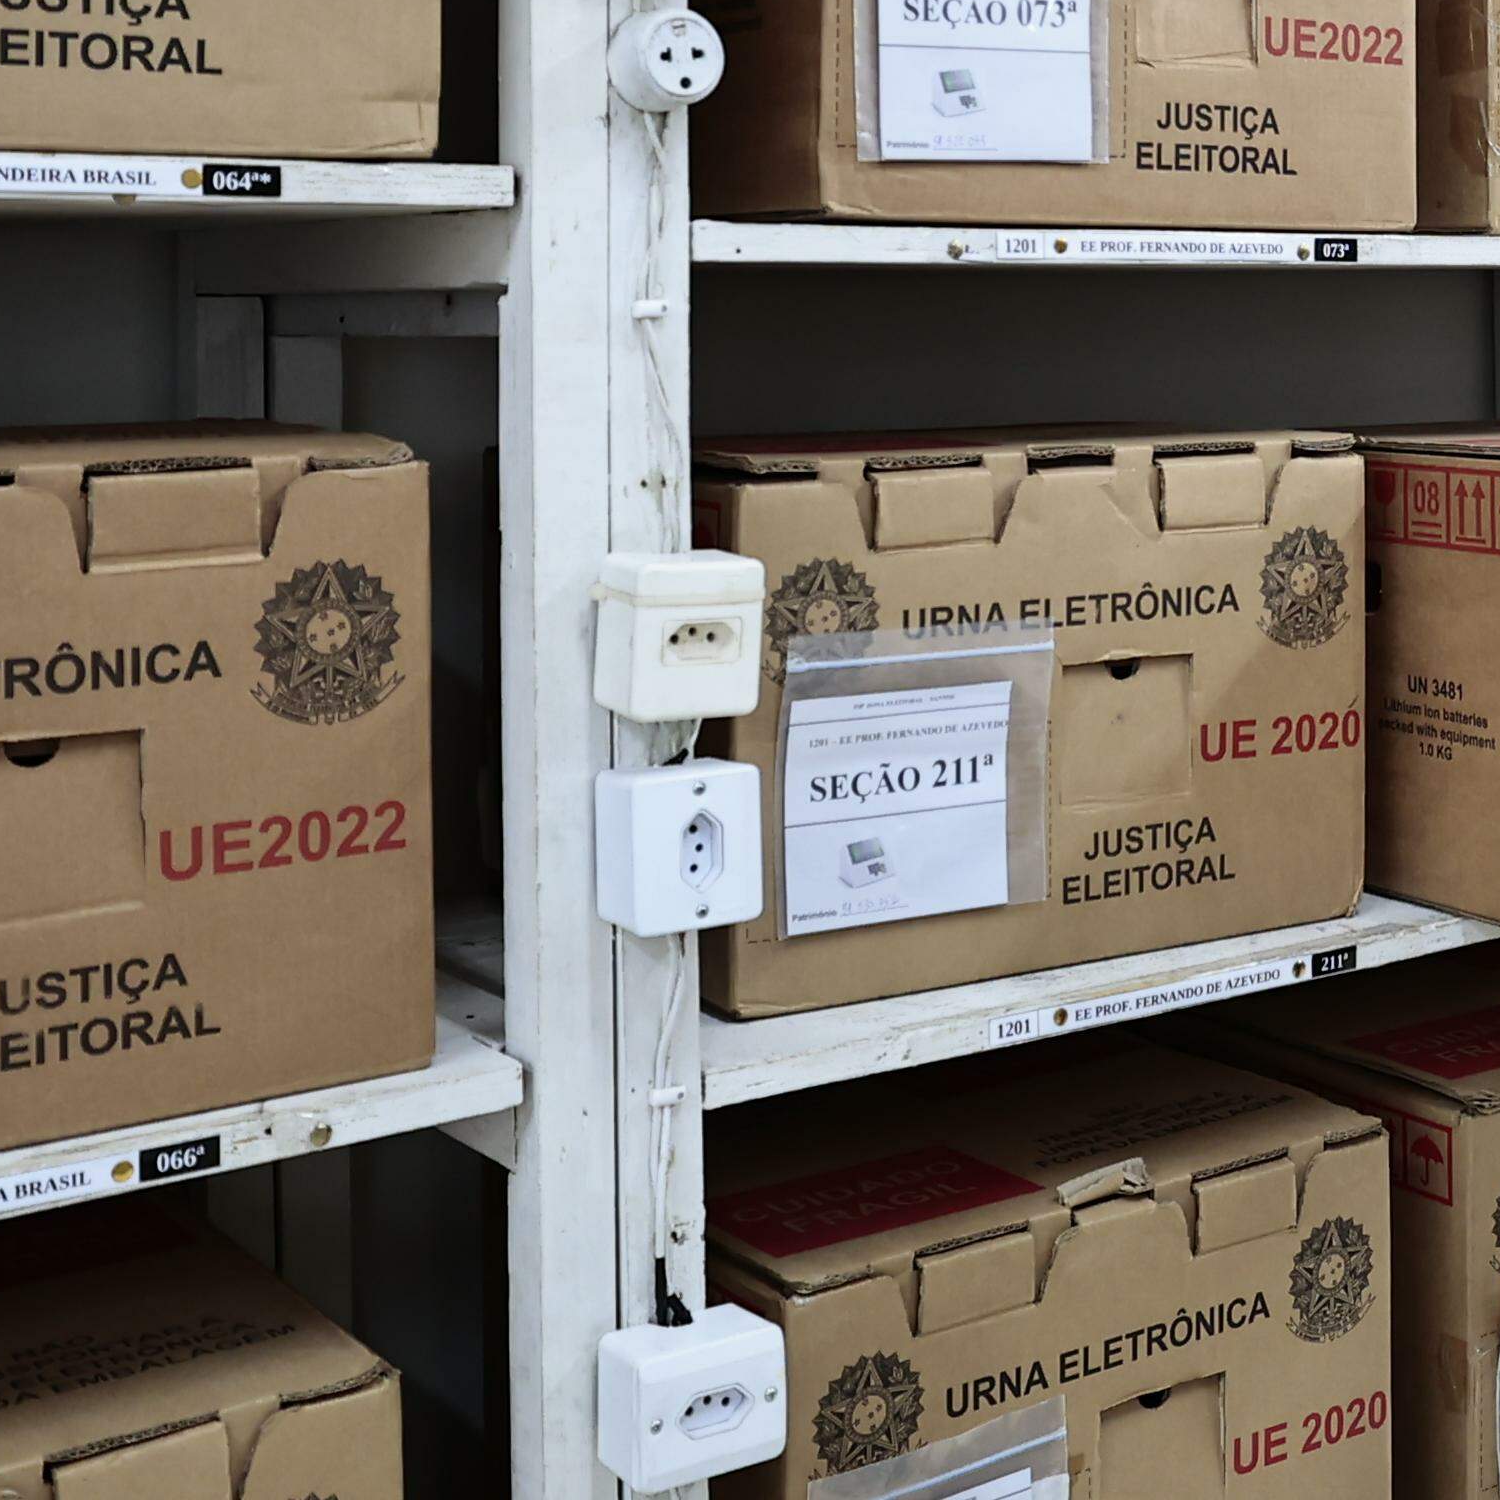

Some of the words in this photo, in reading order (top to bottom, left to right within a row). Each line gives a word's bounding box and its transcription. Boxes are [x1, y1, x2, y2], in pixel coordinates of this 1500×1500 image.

[1263, 17, 1405, 67] UE2022
[1157, 101, 1280, 138] JUSTIÇA
[1136, 141, 1298, 177] ELEITORAL
[82, 167, 157, 188] BRASIL
[1005, 238, 1037, 254] 1201
[1080, 239, 1097, 253] EE
[1140, 240, 1207, 255] FERNANDO
[1209, 241, 1226, 255] DE
[1228, 242, 1284, 256] AZEVEDO
[1322, 241, 1350, 259] 073ª
[1413, 480, 1440, 516] 08
[902, 604, 1009, 641] URNA
[1019, 582, 1240, 632] ELETRÔNICA
[1407, 673, 1429, 695] UN
[1432, 678, 1464, 701] 3481
[1442, 707, 1489, 730] batteries
[1200, 721, 1258, 762] UE
[1416, 722, 1438, 740] with
[1440, 728, 1497, 754] equipment
[1418, 741, 1435, 759] 1.0
[1436, 744, 1454, 762] KG
[810, 761, 921, 804] SEÇÃO
[932, 753, 994, 789] 211ª
[157, 800, 409, 884] UE2022
[1084, 816, 1217, 863] JUSTIÇA
[1062, 854, 1236, 906] ELEITORAL
[1321, 951, 1349, 973] 211ª
[1075, 1007, 1092, 1023] EE
[1135, 986, 1204, 1010] FERNANDO
[1206, 980, 1223, 995] DE
[1224, 968, 1281, 991] AZEVEDO
[997, 1019, 1032, 1039] 1201
[155, 1144, 208, 1175] 066ª
[13, 1169, 93, 1200] BRASIL
[946, 1358, 1049, 1419] URNA
[1058, 1290, 1271, 1384] ELETRÔNICA
[1232, 1421, 1288, 1475] UE
[1301, 1389, 1388, 1454] 2020
